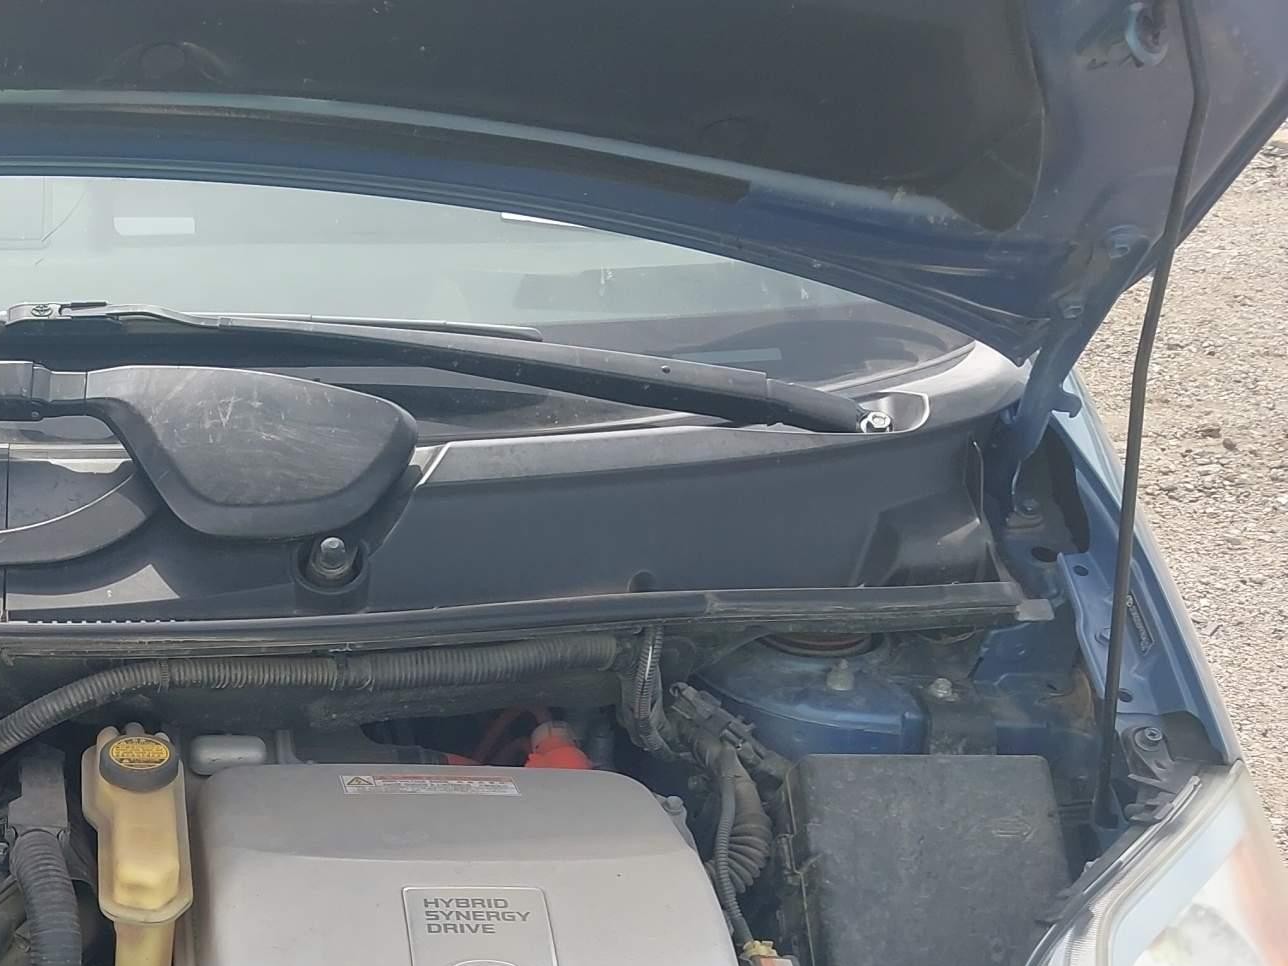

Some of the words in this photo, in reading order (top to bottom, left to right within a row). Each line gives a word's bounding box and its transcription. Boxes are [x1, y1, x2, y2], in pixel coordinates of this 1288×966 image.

[423, 898, 508, 908] HYBRID
[424, 910, 530, 921] SYNERGY
[427, 923, 496, 933] DRIVE
